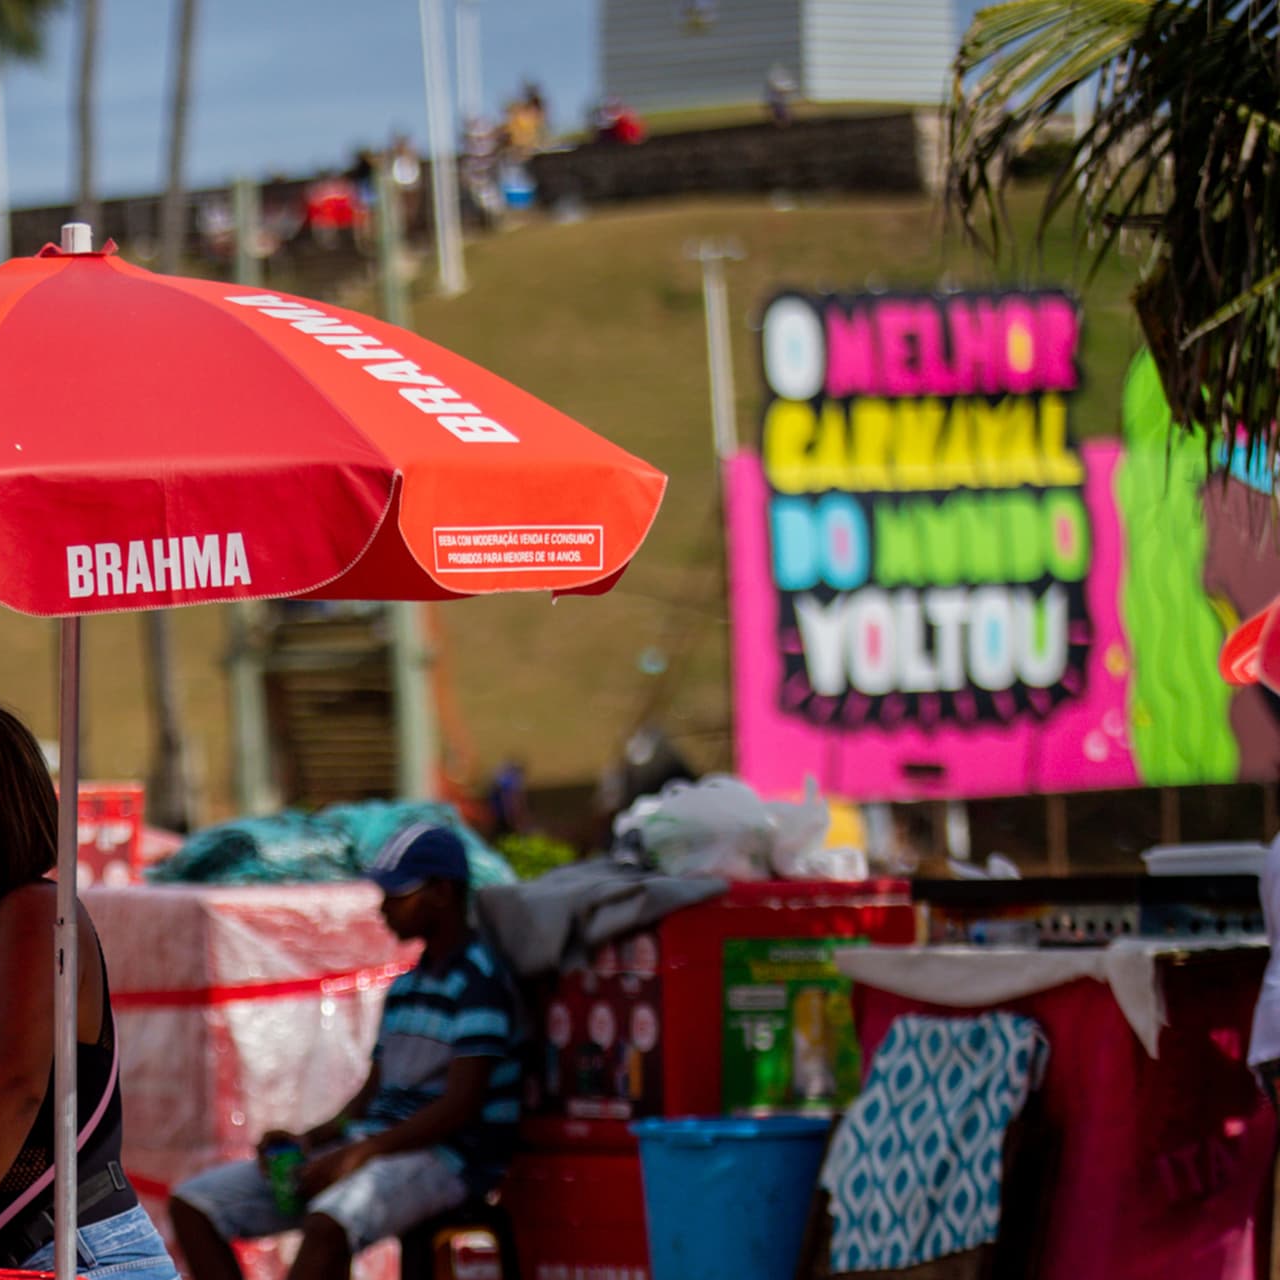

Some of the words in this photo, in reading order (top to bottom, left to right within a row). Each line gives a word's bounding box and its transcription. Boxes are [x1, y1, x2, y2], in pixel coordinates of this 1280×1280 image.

[224, 294, 520, 443] BRAHMA
[763, 297, 825, 400] O
[826, 298, 1078, 397] MELHOR
[765, 396, 1085, 494] CARNAVAL
[66, 532, 252, 599] BRAHMA
[551, 532, 595, 545] CONSUMO
[772, 493, 870, 590] DO
[795, 585, 1068, 696] VOLTOU
